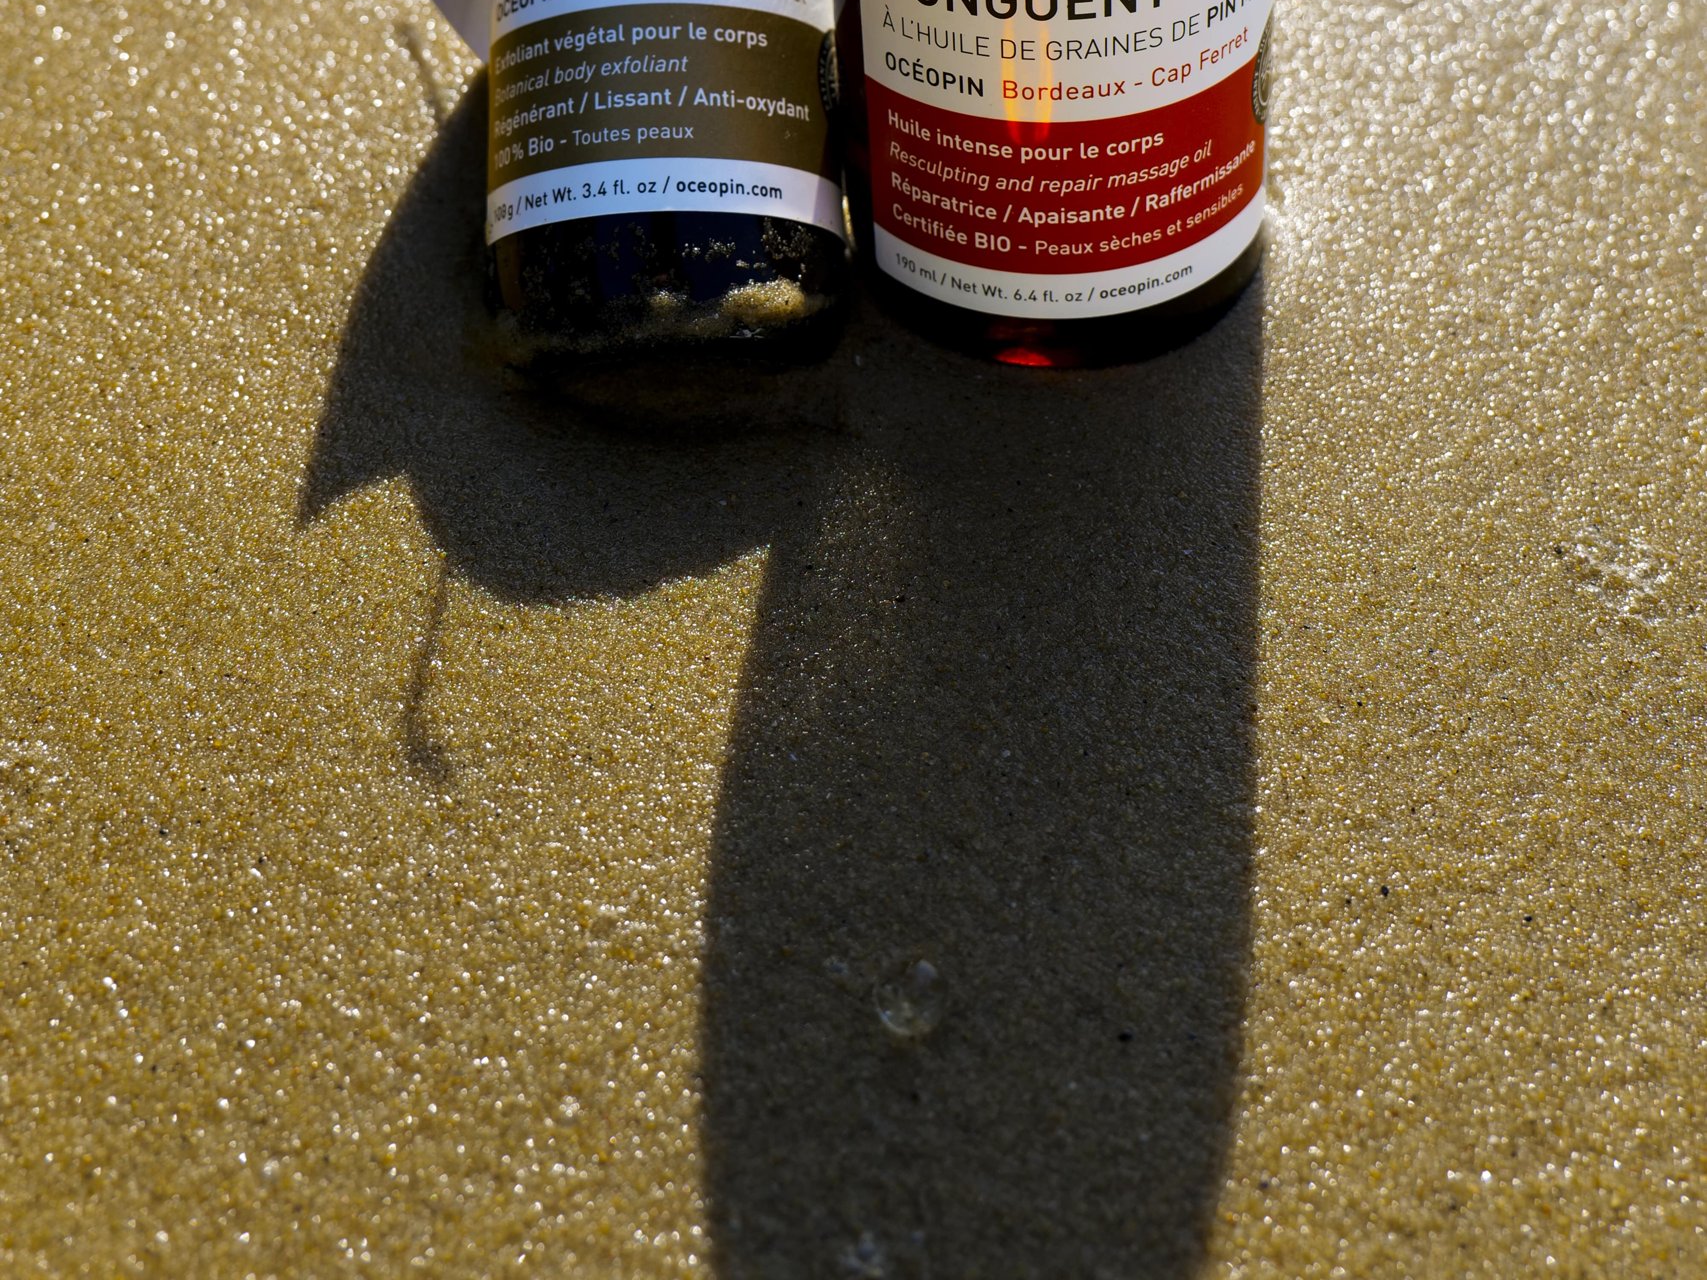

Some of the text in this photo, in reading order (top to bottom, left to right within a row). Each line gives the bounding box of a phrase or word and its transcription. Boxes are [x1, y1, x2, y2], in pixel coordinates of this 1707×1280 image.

[495, 22, 768, 75] Exfoliant végétal pour le corps
[883, 4, 895, 32] À
[901, 16, 990, 58] L'HUILE
[1000, 38, 1036, 61] DE
[1046, 27, 1163, 61] GRAINES
[1172, 13, 1200, 42] DE
[494, 54, 689, 107] Botanical body exfoliant
[885, 51, 984, 97] OCÉOPIN
[1002, 79, 1126, 101] Bordeaux
[1152, 62, 1192, 88] Cap
[1199, 26, 1248, 70] Ferret
[494, 85, 811, 138] Régénérant / Lissant / Anti-oxydant
[888, 108, 1165, 164] Huile intense pour le corps
[528, 136, 554, 157] Bio
[572, 127, 631, 147] Toutes
[637, 125, 695, 144] peaux
[889, 138, 1213, 197] Resculpting and repair massage oil
[516, 196, 523, 216] /
[525, 192, 548, 212] Net
[552, 187, 577, 204] Wt.
[582, 181, 607, 199] 3.4
[613, 179, 630, 196] fl.
[637, 181, 657, 194] oz
[662, 176, 671, 194] /
[676, 179, 783, 200] oceopin.com
[891, 139, 1256, 228] Réparatrice / Apaisante / Raffermissante
[892, 203, 968, 245] Certifiée
[974, 231, 1011, 253] BIO
[1035, 240, 1093, 255] Peaux
[1099, 228, 1162, 253] sèches
[1166, 219, 1182, 236] et
[1186, 183, 1244, 228] sensibles
[896, 253, 1193, 302] 190 ml / Net Wt. 6.4 fl. oz / oceopin.com
